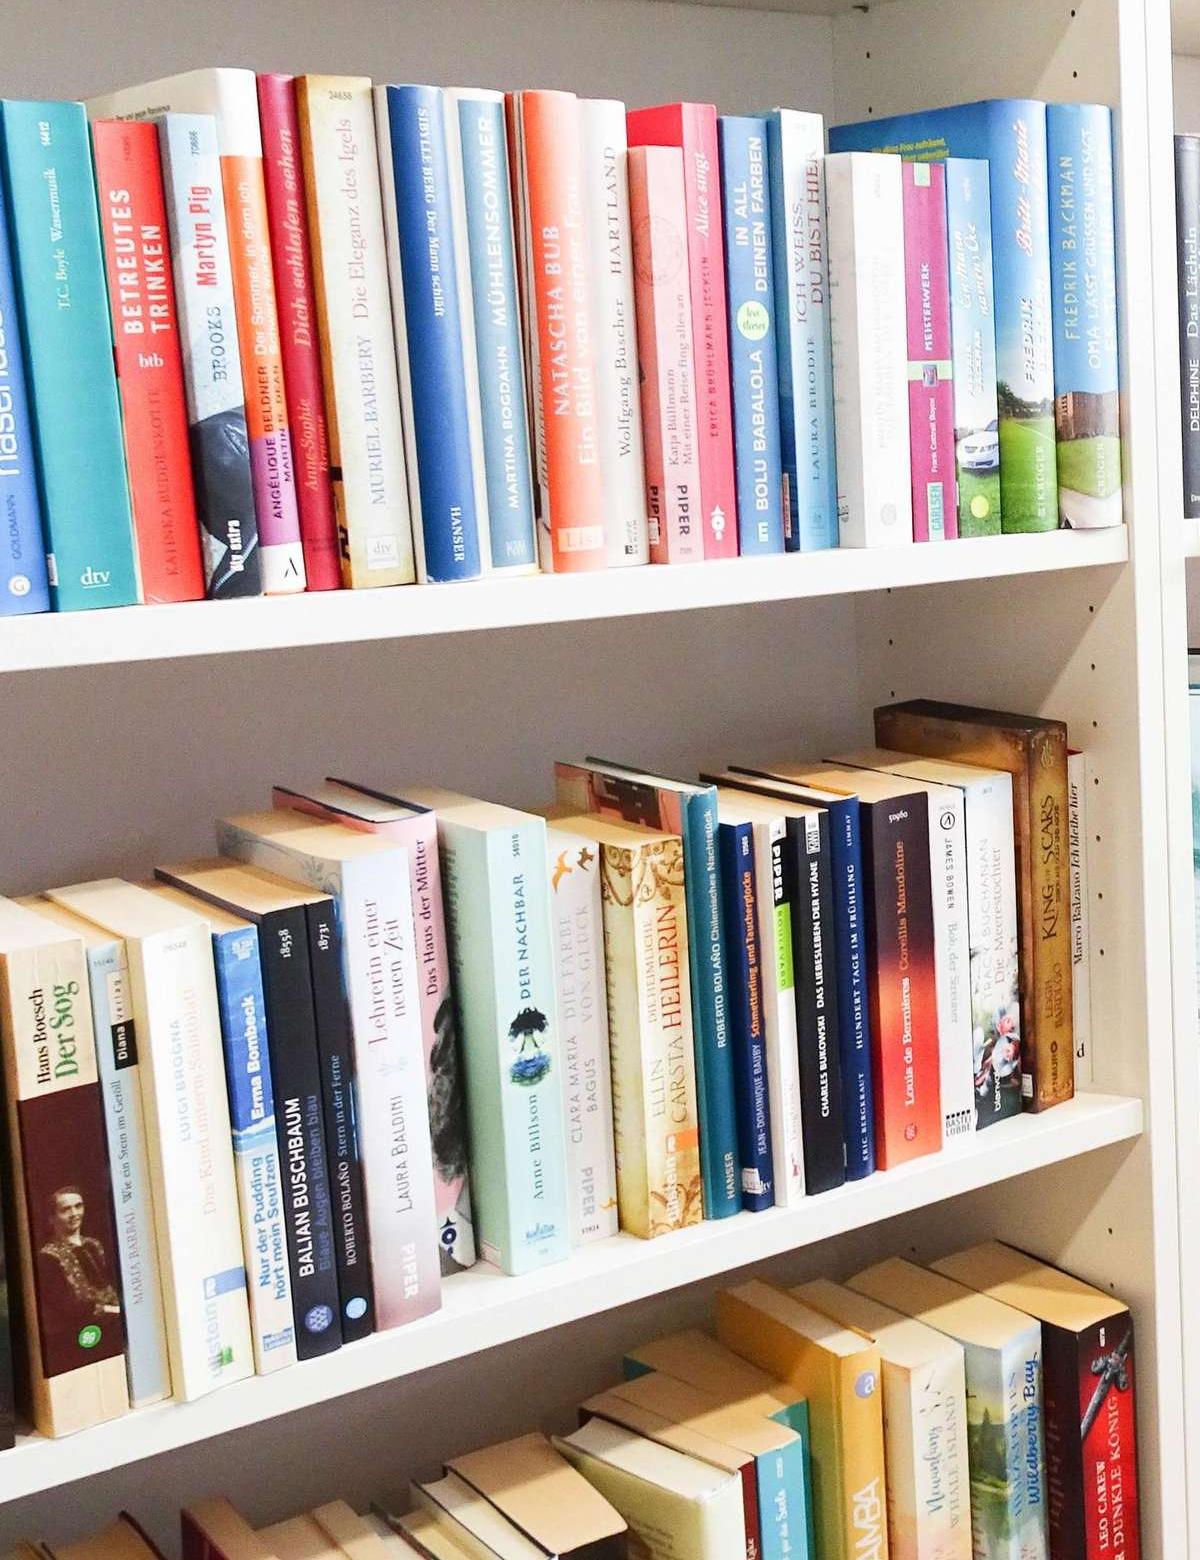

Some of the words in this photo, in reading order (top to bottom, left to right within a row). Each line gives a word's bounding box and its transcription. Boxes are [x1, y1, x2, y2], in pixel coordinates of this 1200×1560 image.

[277, 128, 297, 191] sehen
[336, 118, 359, 163] Igels
[188, 185, 212, 215] Pig
[340, 169, 359, 201] des
[732, 180, 748, 218] ALL
[747, 136, 764, 213] FARBEN
[800, 151, 821, 204] HIER
[43, 167, 64, 242] Wassermusik
[478, 116, 508, 327] MÜHLENSOMMER
[603, 146, 623, 275] HARTLAND
[1057, 155, 1077, 251] BACKMAN
[109, 188, 145, 335] BETREUTES
[141, 224, 171, 333] TRINKEN
[193, 222, 218, 286] Martyn
[283, 198, 308, 289] schlafen
[344, 206, 370, 281] Eleganz
[541, 225, 562, 276] BUB
[734, 226, 748, 246] IN
[750, 220, 767, 292] DEINEN
[804, 211, 822, 262] BIST
[1185, 227, 1197, 297] Lächeln
[53, 249, 71, 281] Boyle
[806, 270, 823, 305] DU
[56, 284, 71, 309] T.C.
[290, 298, 312, 346] Dich
[351, 286, 370, 319] Die
[919, 262, 934, 352] MEISTERWERK
[1061, 262, 1080, 340] FREDRIK
[1188, 302, 1197, 337] Das
[207, 306, 228, 381] BROOKS
[547, 288, 571, 416] NATASCHA
[610, 299, 630, 369] Büscher
[258, 366, 274, 432] BELDNER
[357, 334, 380, 422] BARBERY
[495, 345, 514, 429] BOGDAHN
[745, 350, 766, 450] BABALOLA
[1190, 359, 1200, 432] DELPHINE
[615, 377, 634, 457] Wolfgang
[264, 437, 283, 519] ANGÉLIQUE
[365, 427, 387, 505] MURIEL
[501, 434, 521, 508] MARTINA
[750, 459, 769, 511] BOLU
[677, 484, 690, 535] PIPER
[928, 484, 941, 531] CARLSEN
[1066, 782, 1078, 807] hier
[702, 809, 715, 871] Nachtstück
[1039, 795, 1055, 867] SCARS
[1067, 810, 1079, 845] bleibe
[412, 839, 431, 892] Mütter
[806, 861, 819, 896] HYÄNE
[1068, 848, 1081, 868] Ich
[418, 895, 433, 920] der
[512, 873, 528, 961] NACHBAR
[705, 873, 719, 940] Chilenisches
[810, 897, 820, 918] DER
[845, 864, 859, 928] FRÜHLING
[1041, 886, 1057, 941] KING
[1069, 871, 1081, 922] Balzano
[279, 928, 293, 959] 18558
[317, 923, 331, 951] 18731
[361, 899, 383, 950] einer
[420, 924, 436, 964] Haus
[850, 932, 859, 949] IM
[1072, 926, 1083, 965] Marco
[655, 904, 683, 1030] HEILERIN
[709, 943, 724, 992] BOLAÑO
[811, 922, 824, 984] LIEBESLEBEN
[851, 953, 861, 985] TAGE
[49, 981, 77, 1029] Sog
[363, 951, 389, 1046] Lehrerin
[423, 968, 439, 996] Das
[519, 964, 532, 1000] DER
[815, 987, 826, 1008] DAS
[29, 987, 47, 1042] Boesch
[241, 994, 262, 1073] Bombeck
[713, 995, 727, 1047] ROBERTO
[852, 990, 863, 1049] HUNDERT
[33, 1046, 52, 1084] Hans
[53, 1032, 79, 1078] Der
[115, 1025, 129, 1061] Diana
[816, 1015, 828, 1069] BUKOWSKI
[329, 1054, 343, 1087] Ferne
[666, 1035, 688, 1124] CARSTA
[819, 1072, 831, 1117] CHARLES
[247, 1077, 266, 1120] Erma
[332, 1090, 344, 1110] der
[333, 1113, 345, 1124] in
[525, 1094, 541, 1152] Billson
[284, 1097, 309, 1207] BUSCHBAUM
[333, 1127, 348, 1157] Stern
[388, 1095, 410, 1157] BALDINI
[249, 1156, 270, 1224] Pudding
[262, 1153, 278, 1219] Seufzen
[336, 1161, 354, 1208] BOLAÑO
[392, 1160, 414, 1213] LAURA
[531, 1156, 544, 1200] Anne
[724, 1152, 736, 1199] HANSER
[256, 1228, 268, 1252] der
[268, 1223, 281, 1264] mein
[293, 1211, 315, 1277] BALIAN
[341, 1212, 359, 1265] ROBERTO
[257, 1257, 271, 1287] Nur
[270, 1268, 286, 1299] hört
[1023, 1352, 1039, 1401] Bay
[1106, 1395, 1121, 1460] KÖNIG
[1024, 1403, 1041, 1505] Wildberry
[1096, 1460, 1107, 1513] CAREW
[1110, 1465, 1124, 1545] DUNKLE
[1099, 1518, 1109, 1550] LEO
